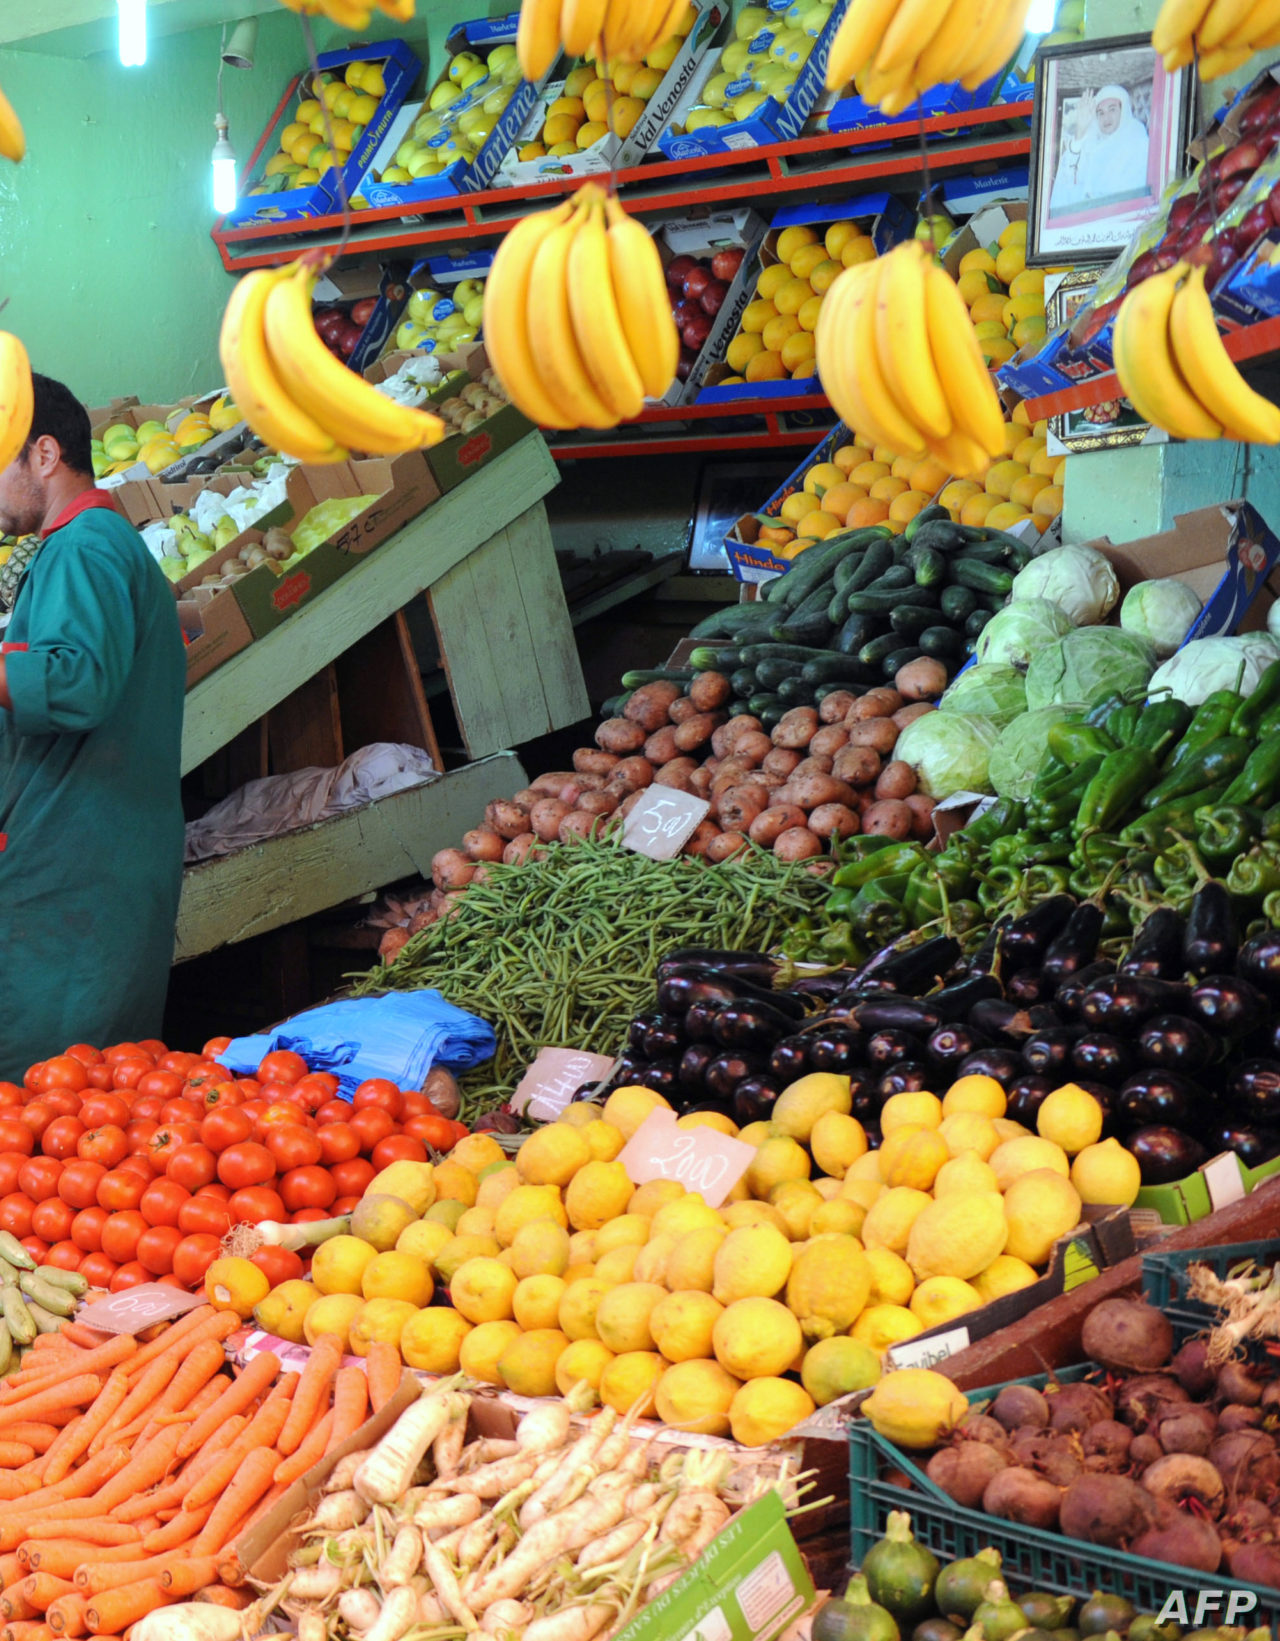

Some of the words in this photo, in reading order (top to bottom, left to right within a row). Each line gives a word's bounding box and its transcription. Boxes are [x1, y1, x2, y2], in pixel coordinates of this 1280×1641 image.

[462, 84, 535, 193] Marlene
[634, 121, 658, 151] Val
[652, 55, 696, 122] Venosta
[708, 290, 749, 363] Venosta
[733, 551, 786, 571] Hinda
